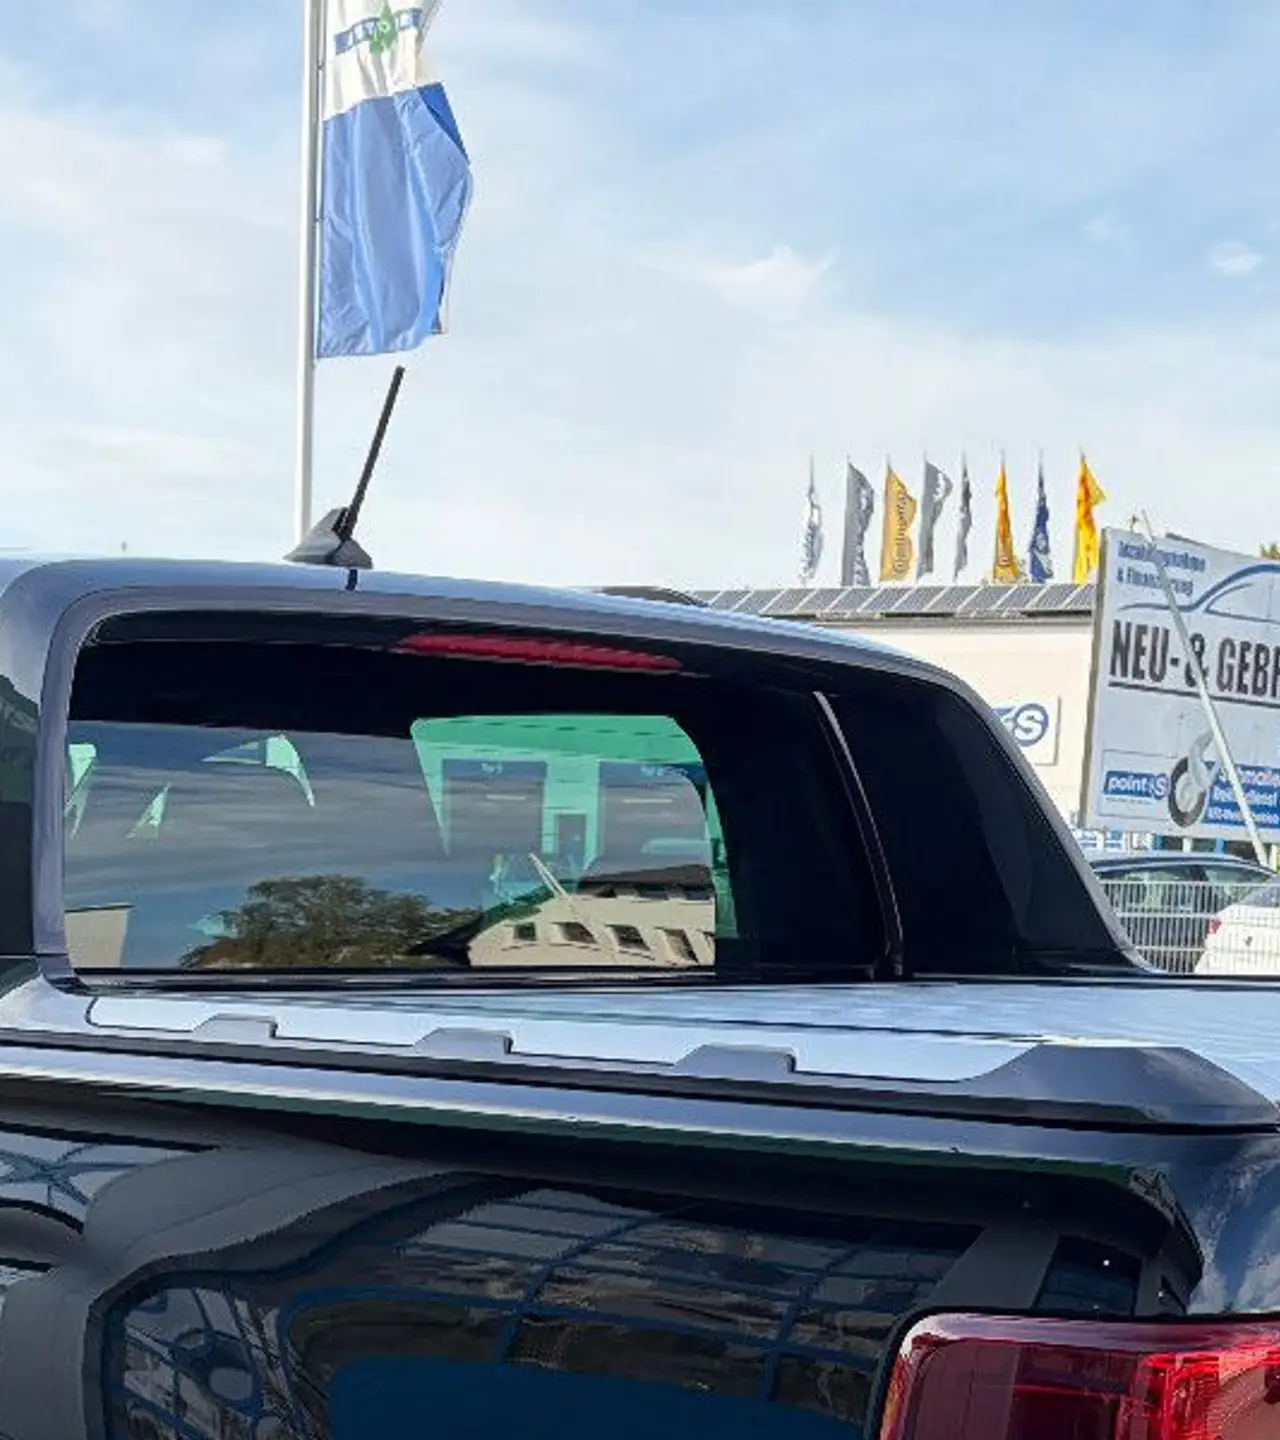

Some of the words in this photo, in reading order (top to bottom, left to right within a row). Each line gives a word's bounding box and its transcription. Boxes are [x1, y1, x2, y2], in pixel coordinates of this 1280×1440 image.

[1109, 618, 1181, 682] NEU-
[1184, 633, 1209, 687] &
[1106, 773, 1149, 795] point
